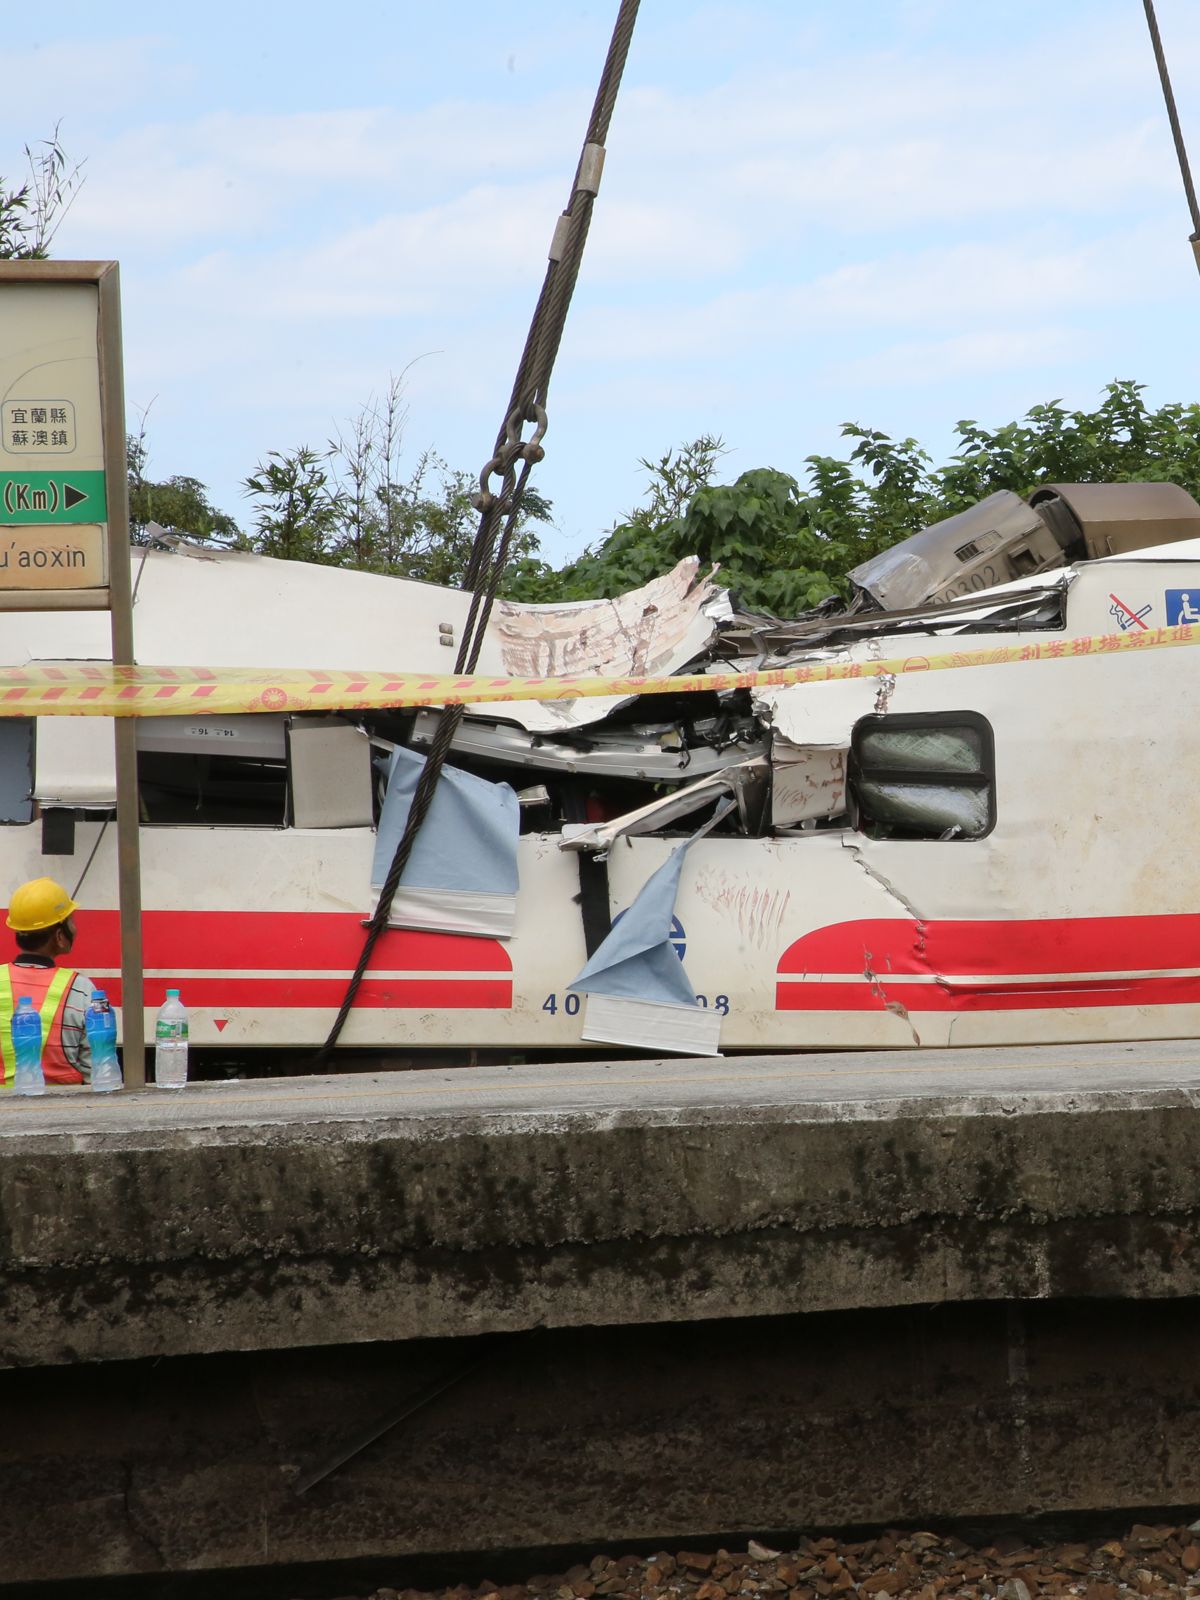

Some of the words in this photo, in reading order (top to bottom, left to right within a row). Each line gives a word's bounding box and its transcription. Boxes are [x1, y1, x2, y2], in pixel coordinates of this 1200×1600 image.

[11, 407, 67, 424] 宜蘭縣
[12, 430, 68, 446] 蘇澳鎮
[4, 480, 59, 515] (Km)
